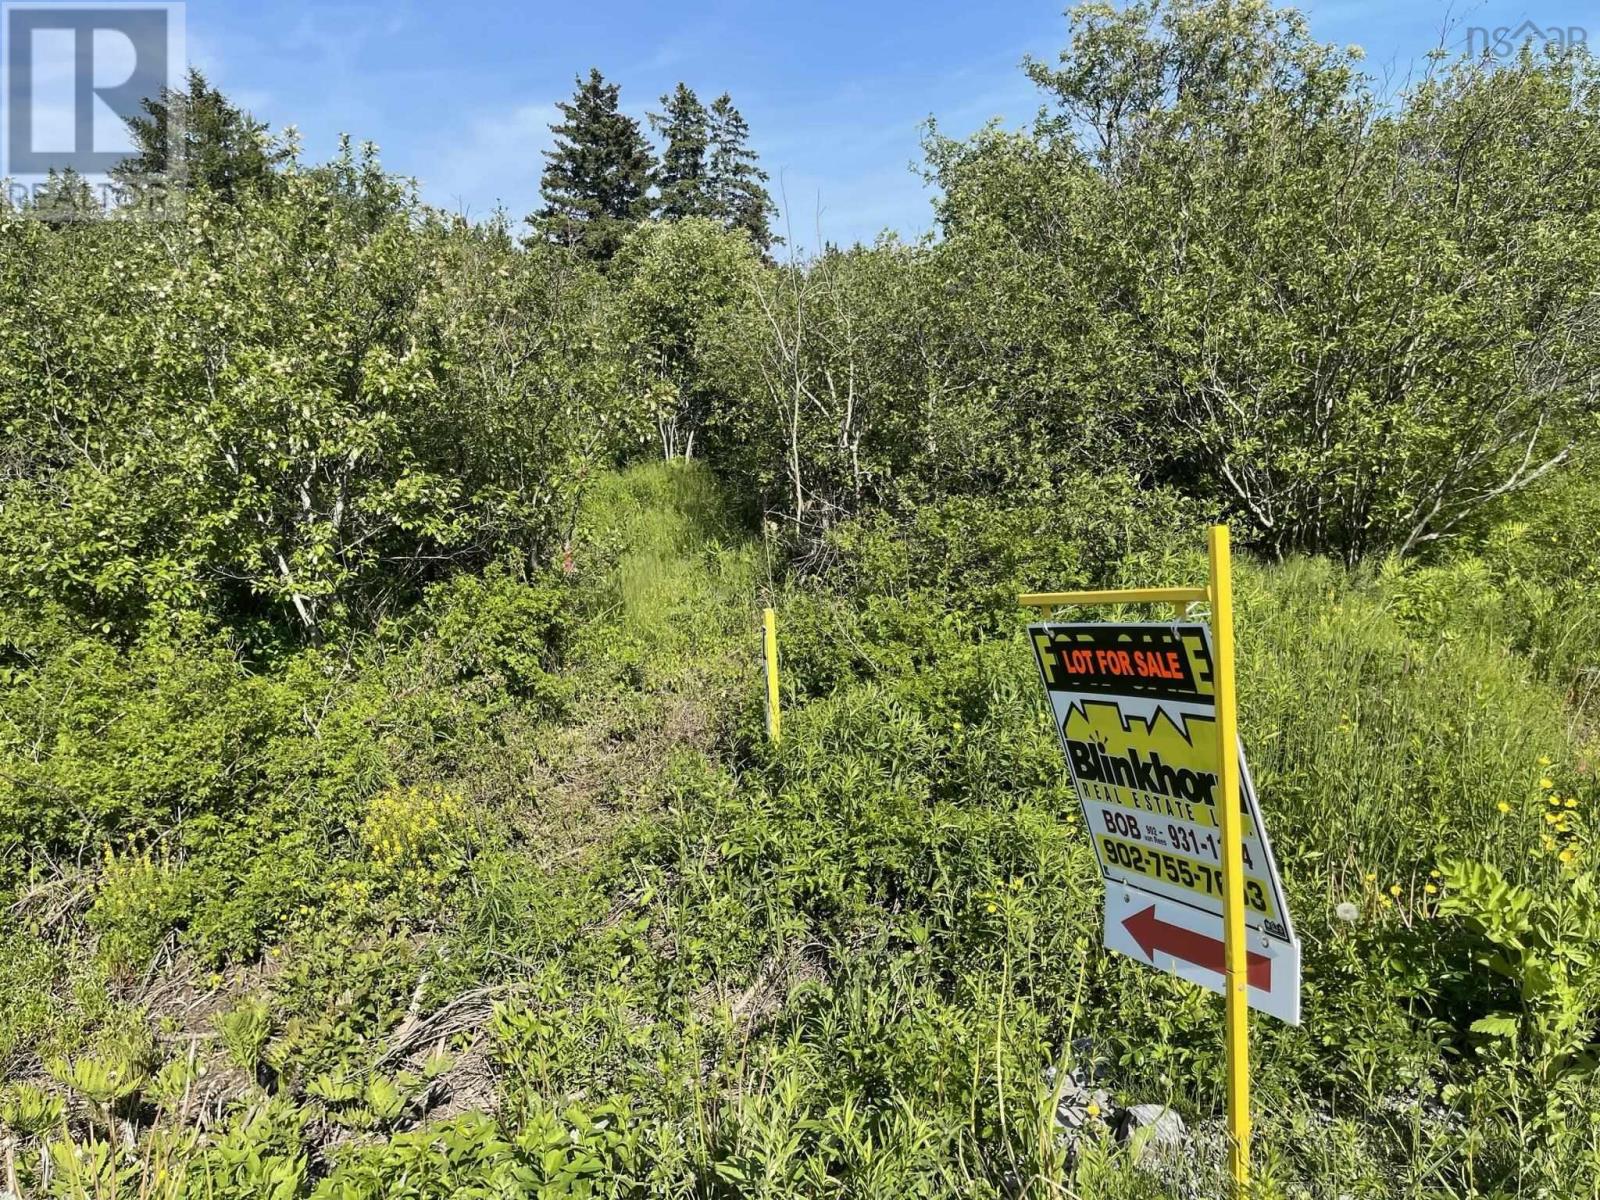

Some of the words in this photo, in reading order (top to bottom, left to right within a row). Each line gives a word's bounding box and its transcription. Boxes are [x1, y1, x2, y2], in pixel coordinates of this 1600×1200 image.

[1061, 649, 1094, 674] LOT
[1097, 650, 1134, 676] FOR
[1133, 651, 1185, 680] SALE
[1082, 782, 1122, 804] REAL
[1134, 792, 1195, 821] ESTATE
[1102, 809, 1141, 840] BOB
[1167, 824, 1254, 870] 931-14
